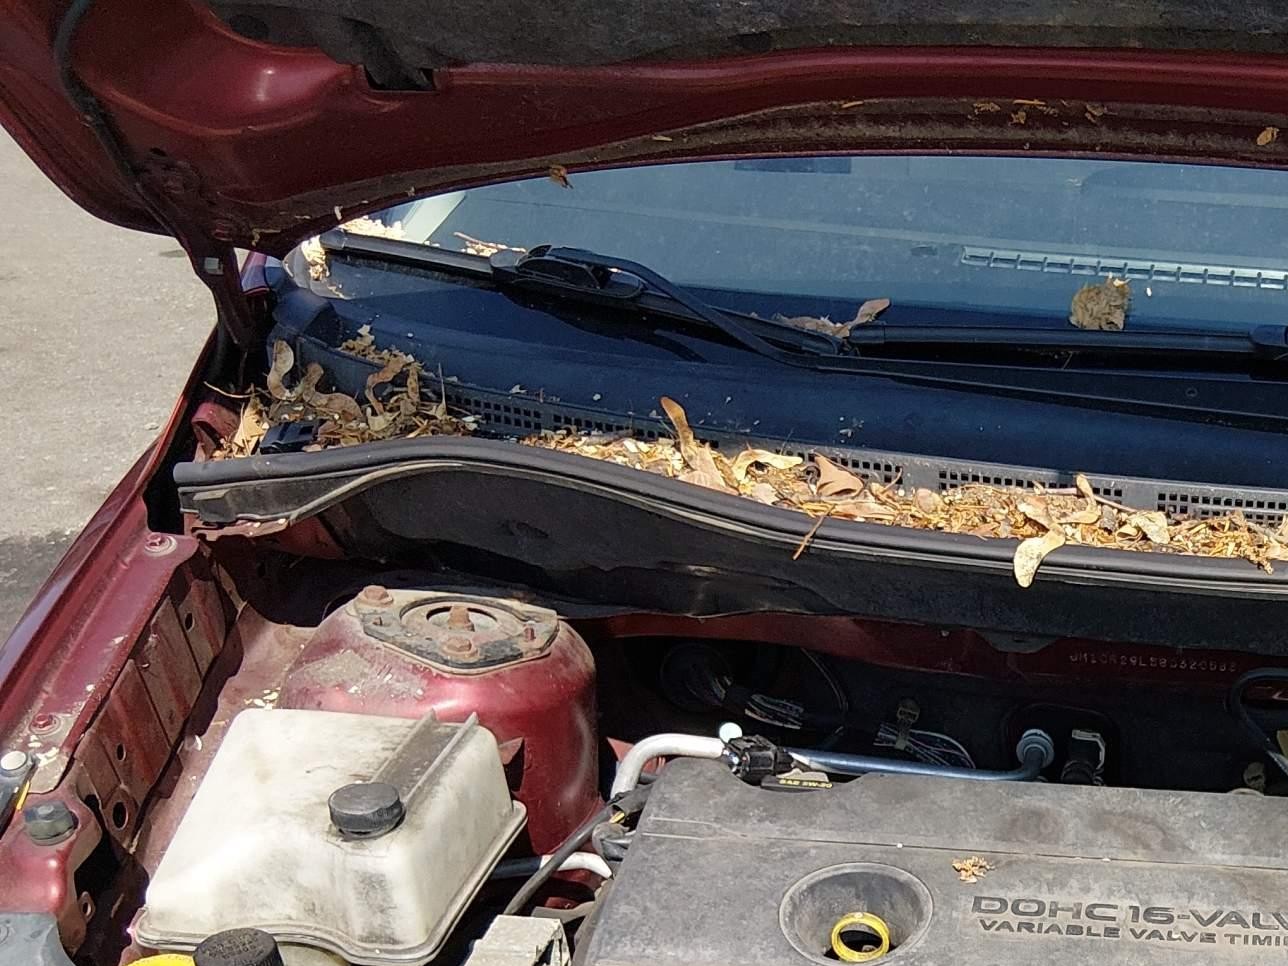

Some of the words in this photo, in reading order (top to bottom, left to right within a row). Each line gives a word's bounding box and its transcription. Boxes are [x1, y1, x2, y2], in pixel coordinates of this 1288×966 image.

[972, 896, 1118, 921] DOHC
[979, 919, 1120, 938] VARIABLE
[1129, 927, 1216, 944] VALVE
